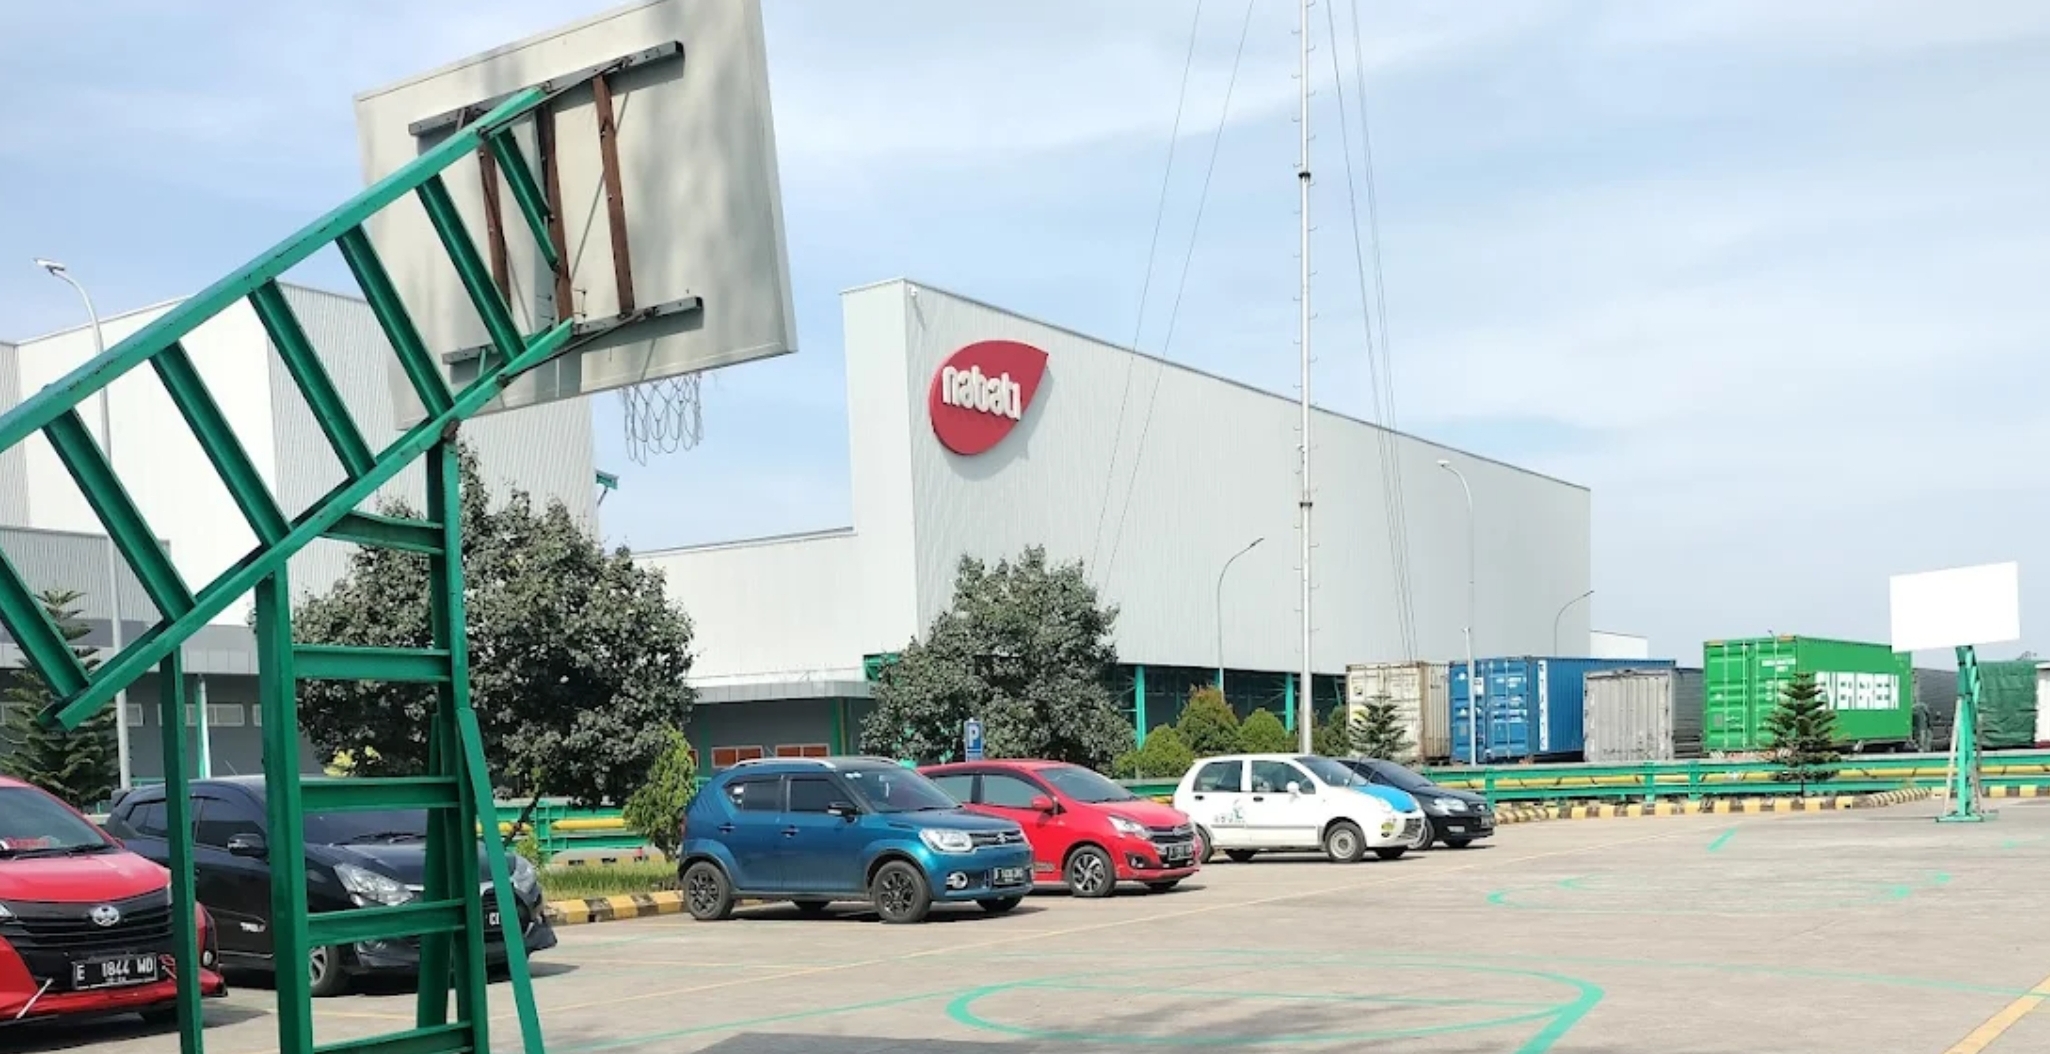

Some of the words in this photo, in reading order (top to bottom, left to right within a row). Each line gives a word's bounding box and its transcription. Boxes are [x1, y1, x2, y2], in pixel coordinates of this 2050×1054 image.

[942, 365, 1021, 420] nabati
[969, 724, 980, 748] P
[76, 964, 86, 981] E
[101, 959, 130, 978] 1844
[136, 956, 154, 974] WD
